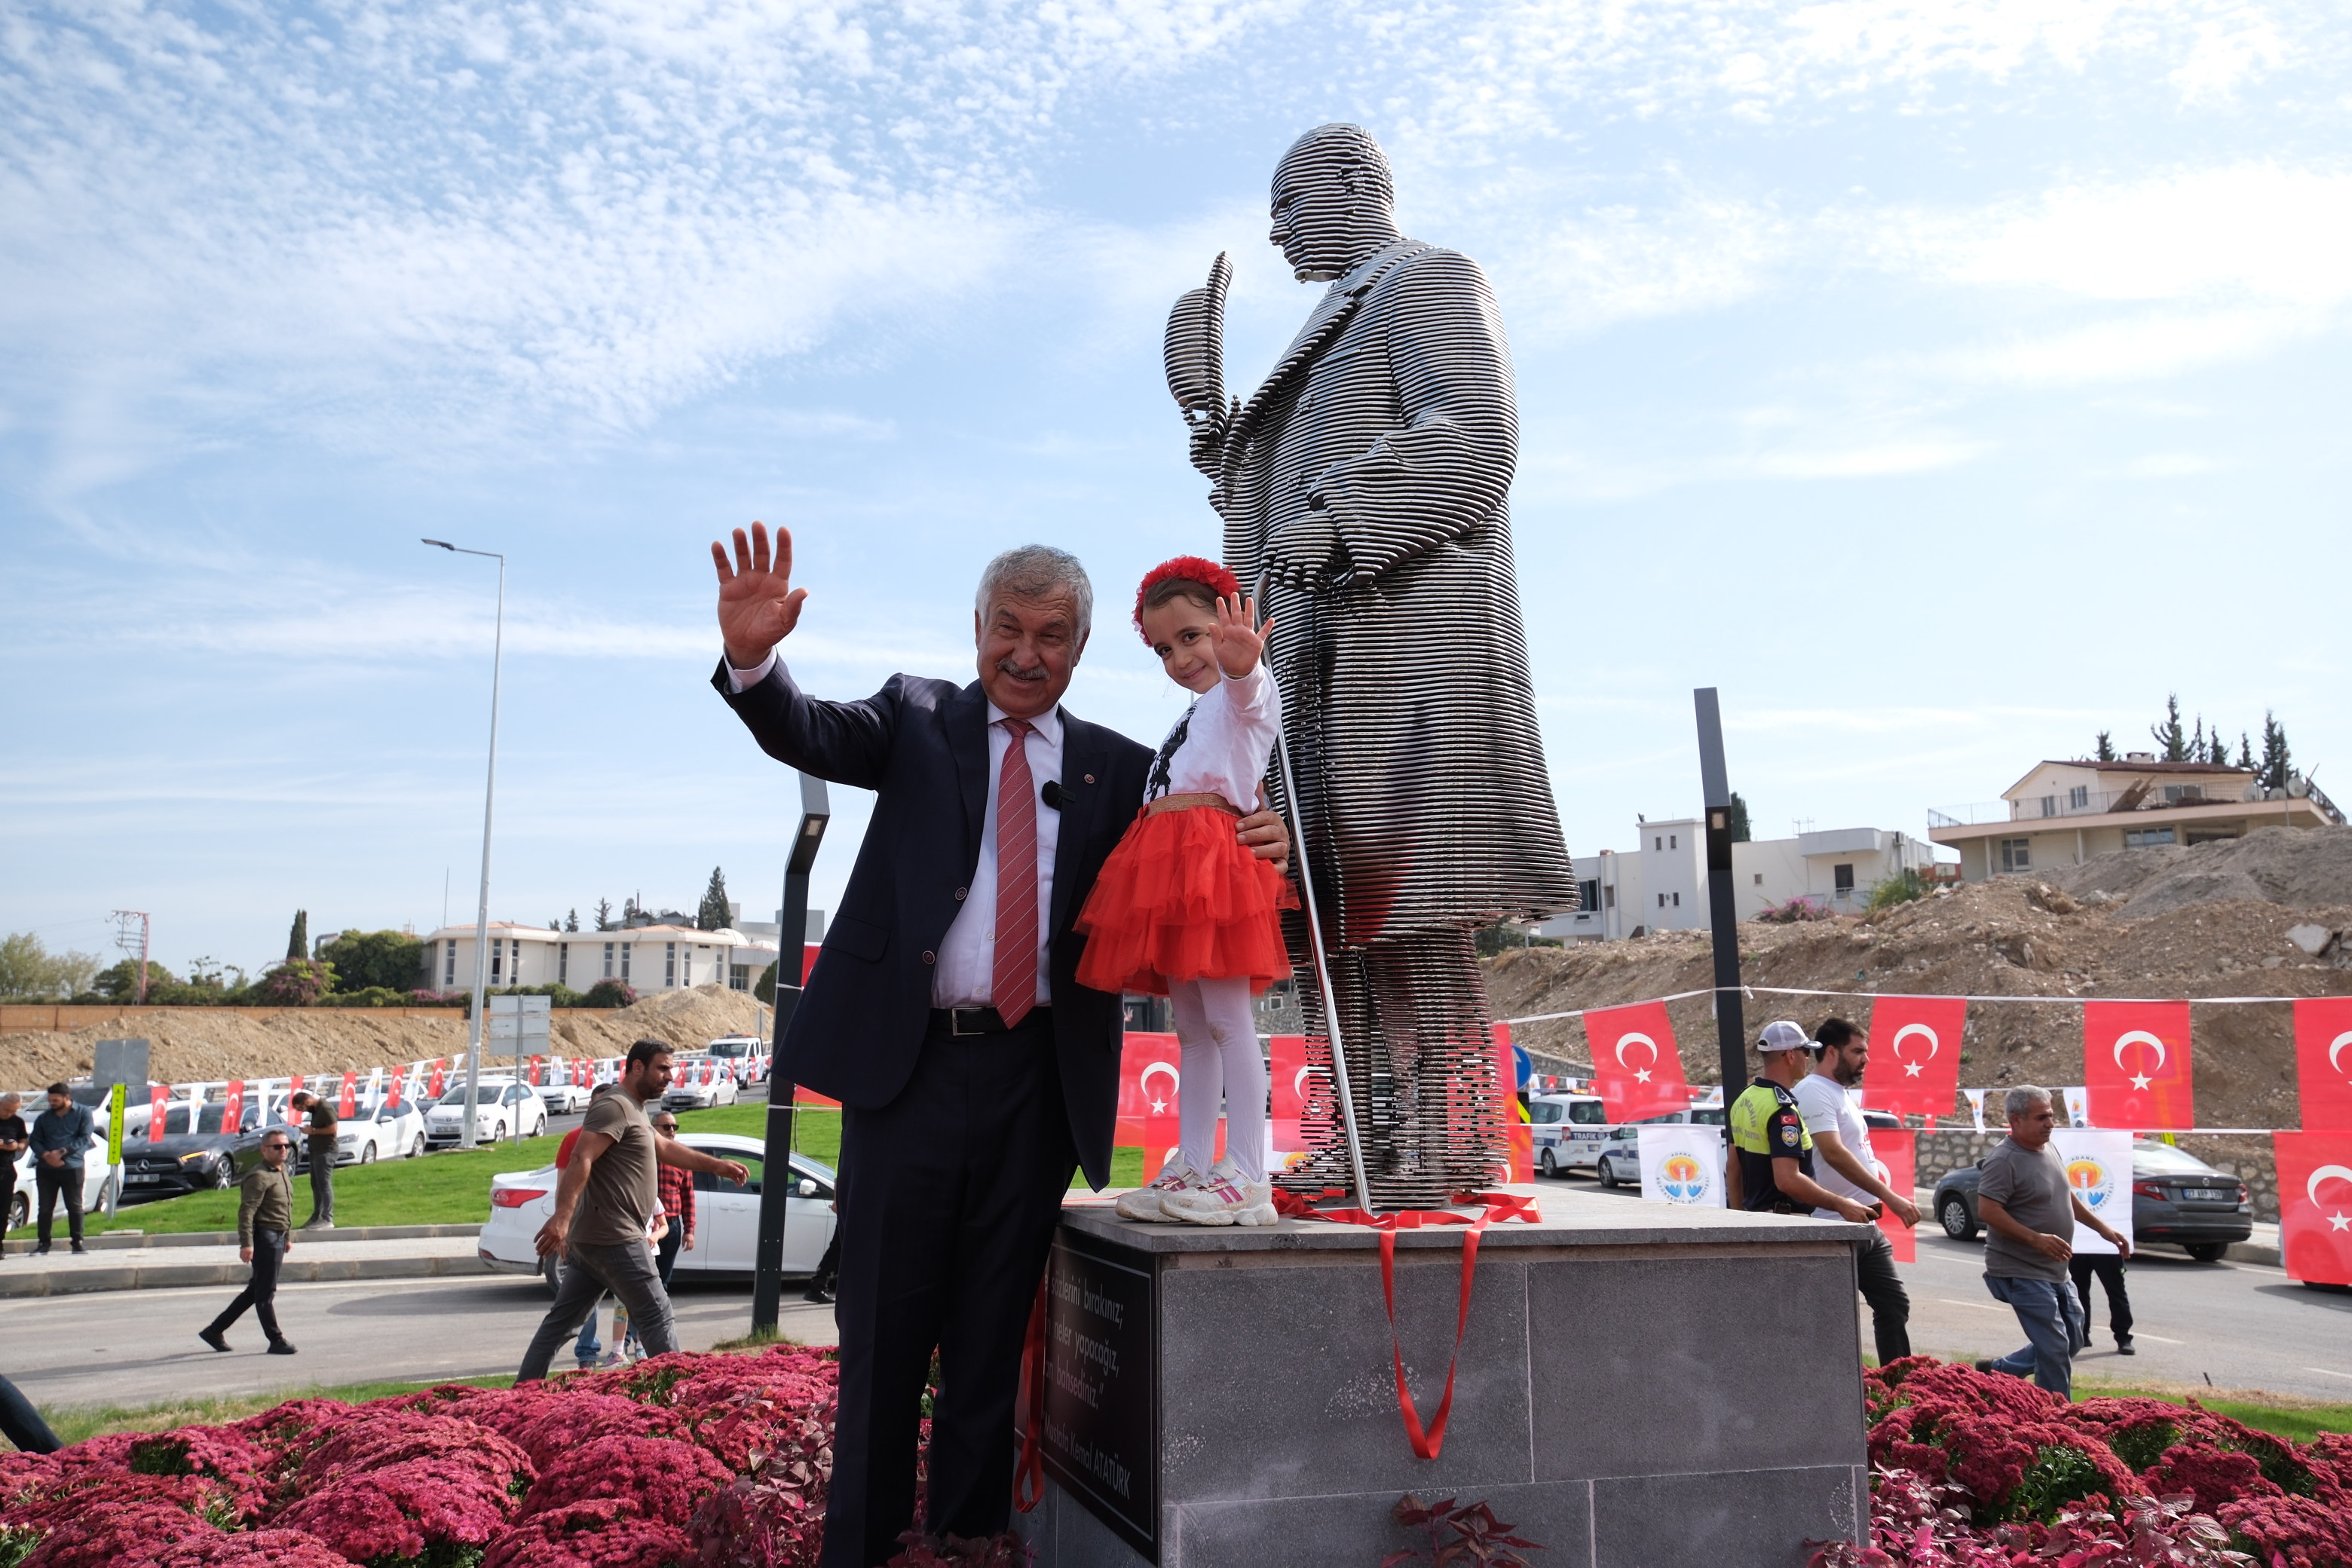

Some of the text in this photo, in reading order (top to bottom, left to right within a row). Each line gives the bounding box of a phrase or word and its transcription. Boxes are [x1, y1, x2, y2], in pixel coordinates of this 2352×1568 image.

[1051, 1269, 1080, 1306] sözlerini
[1084, 1276, 1124, 1331] bırakınız;
[1054, 1312, 1072, 1347] neler
[1075, 1331, 1119, 1379] yapacağız,
[1070, 1432, 1093, 1471] Kemal
[1093, 1447, 1131, 1501] ATATÜRK
